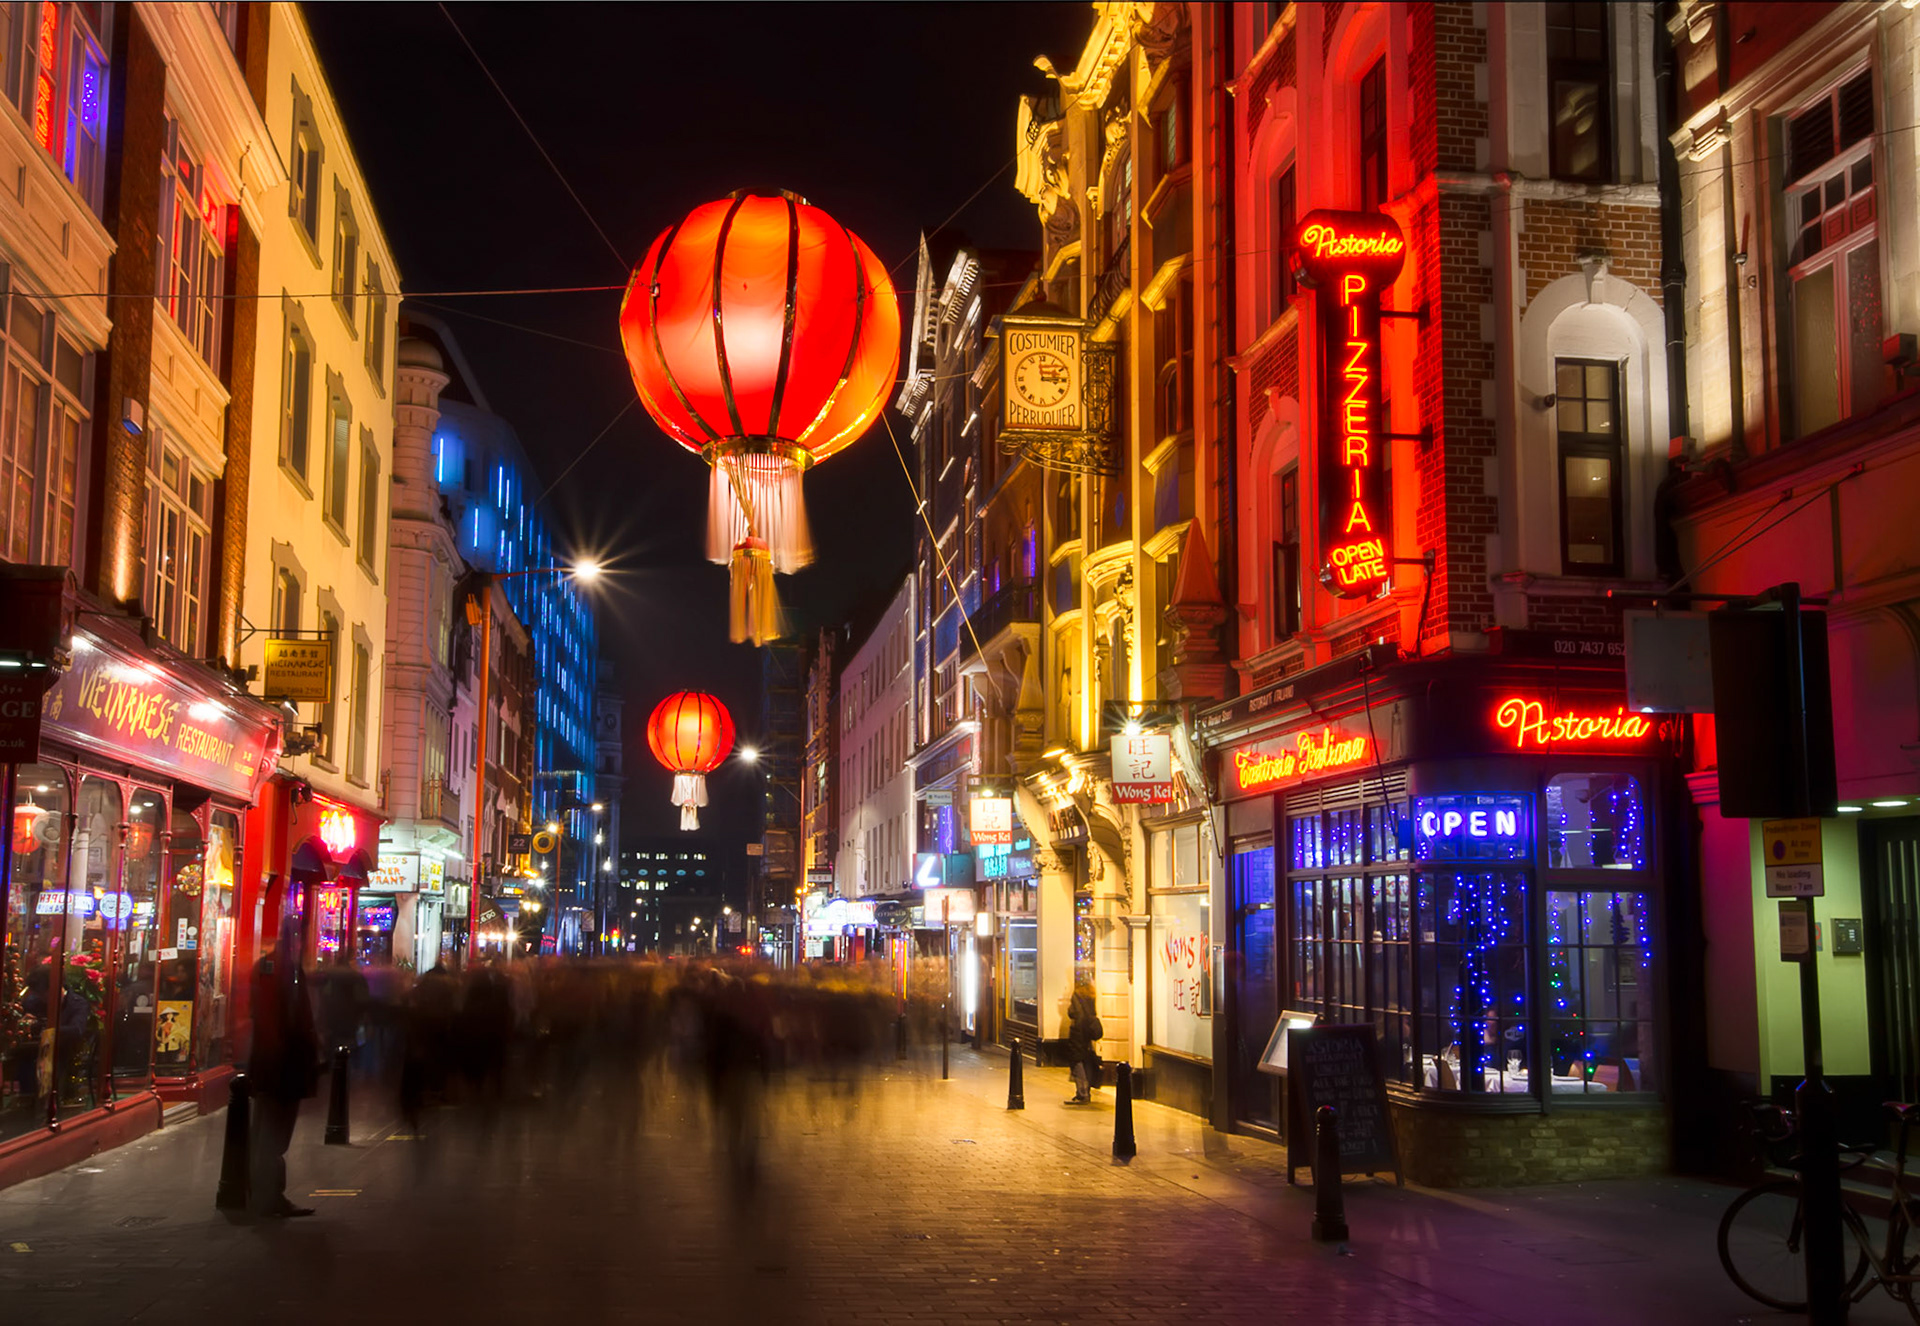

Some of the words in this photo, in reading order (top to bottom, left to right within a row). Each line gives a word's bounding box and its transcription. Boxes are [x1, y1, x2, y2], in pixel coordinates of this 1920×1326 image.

[1303, 224, 1403, 257] Astoria
[1009, 332, 1075, 359] COSTUMIER
[1009, 399, 1075, 427] PERRUQUIER
[1344, 275, 1371, 533] PIZZERIA
[1332, 538, 1384, 566] OPEN
[1340, 558, 1387, 584] LATE
[1554, 640, 1575, 654] 020
[1578, 641, 1604, 655] 7437
[270, 670, 323, 678] RESTAURANT
[78, 667, 180, 746] VIETNAMESE
[1496, 698, 1651, 747] Astoria
[175, 722, 235, 767] RESTAURANT
[1128, 737, 1156, 780] 旺記
[1115, 785, 1151, 802] Wong
[1154, 784, 1171, 799] Kei
[973, 832, 997, 843] Wong
[998, 832, 1011, 841] Kei
[1422, 810, 1516, 837] OPEN
[513, 838, 526, 847] 22
[1158, 930, 1195, 974] Wong
[1173, 977, 1203, 1017] 旺記
